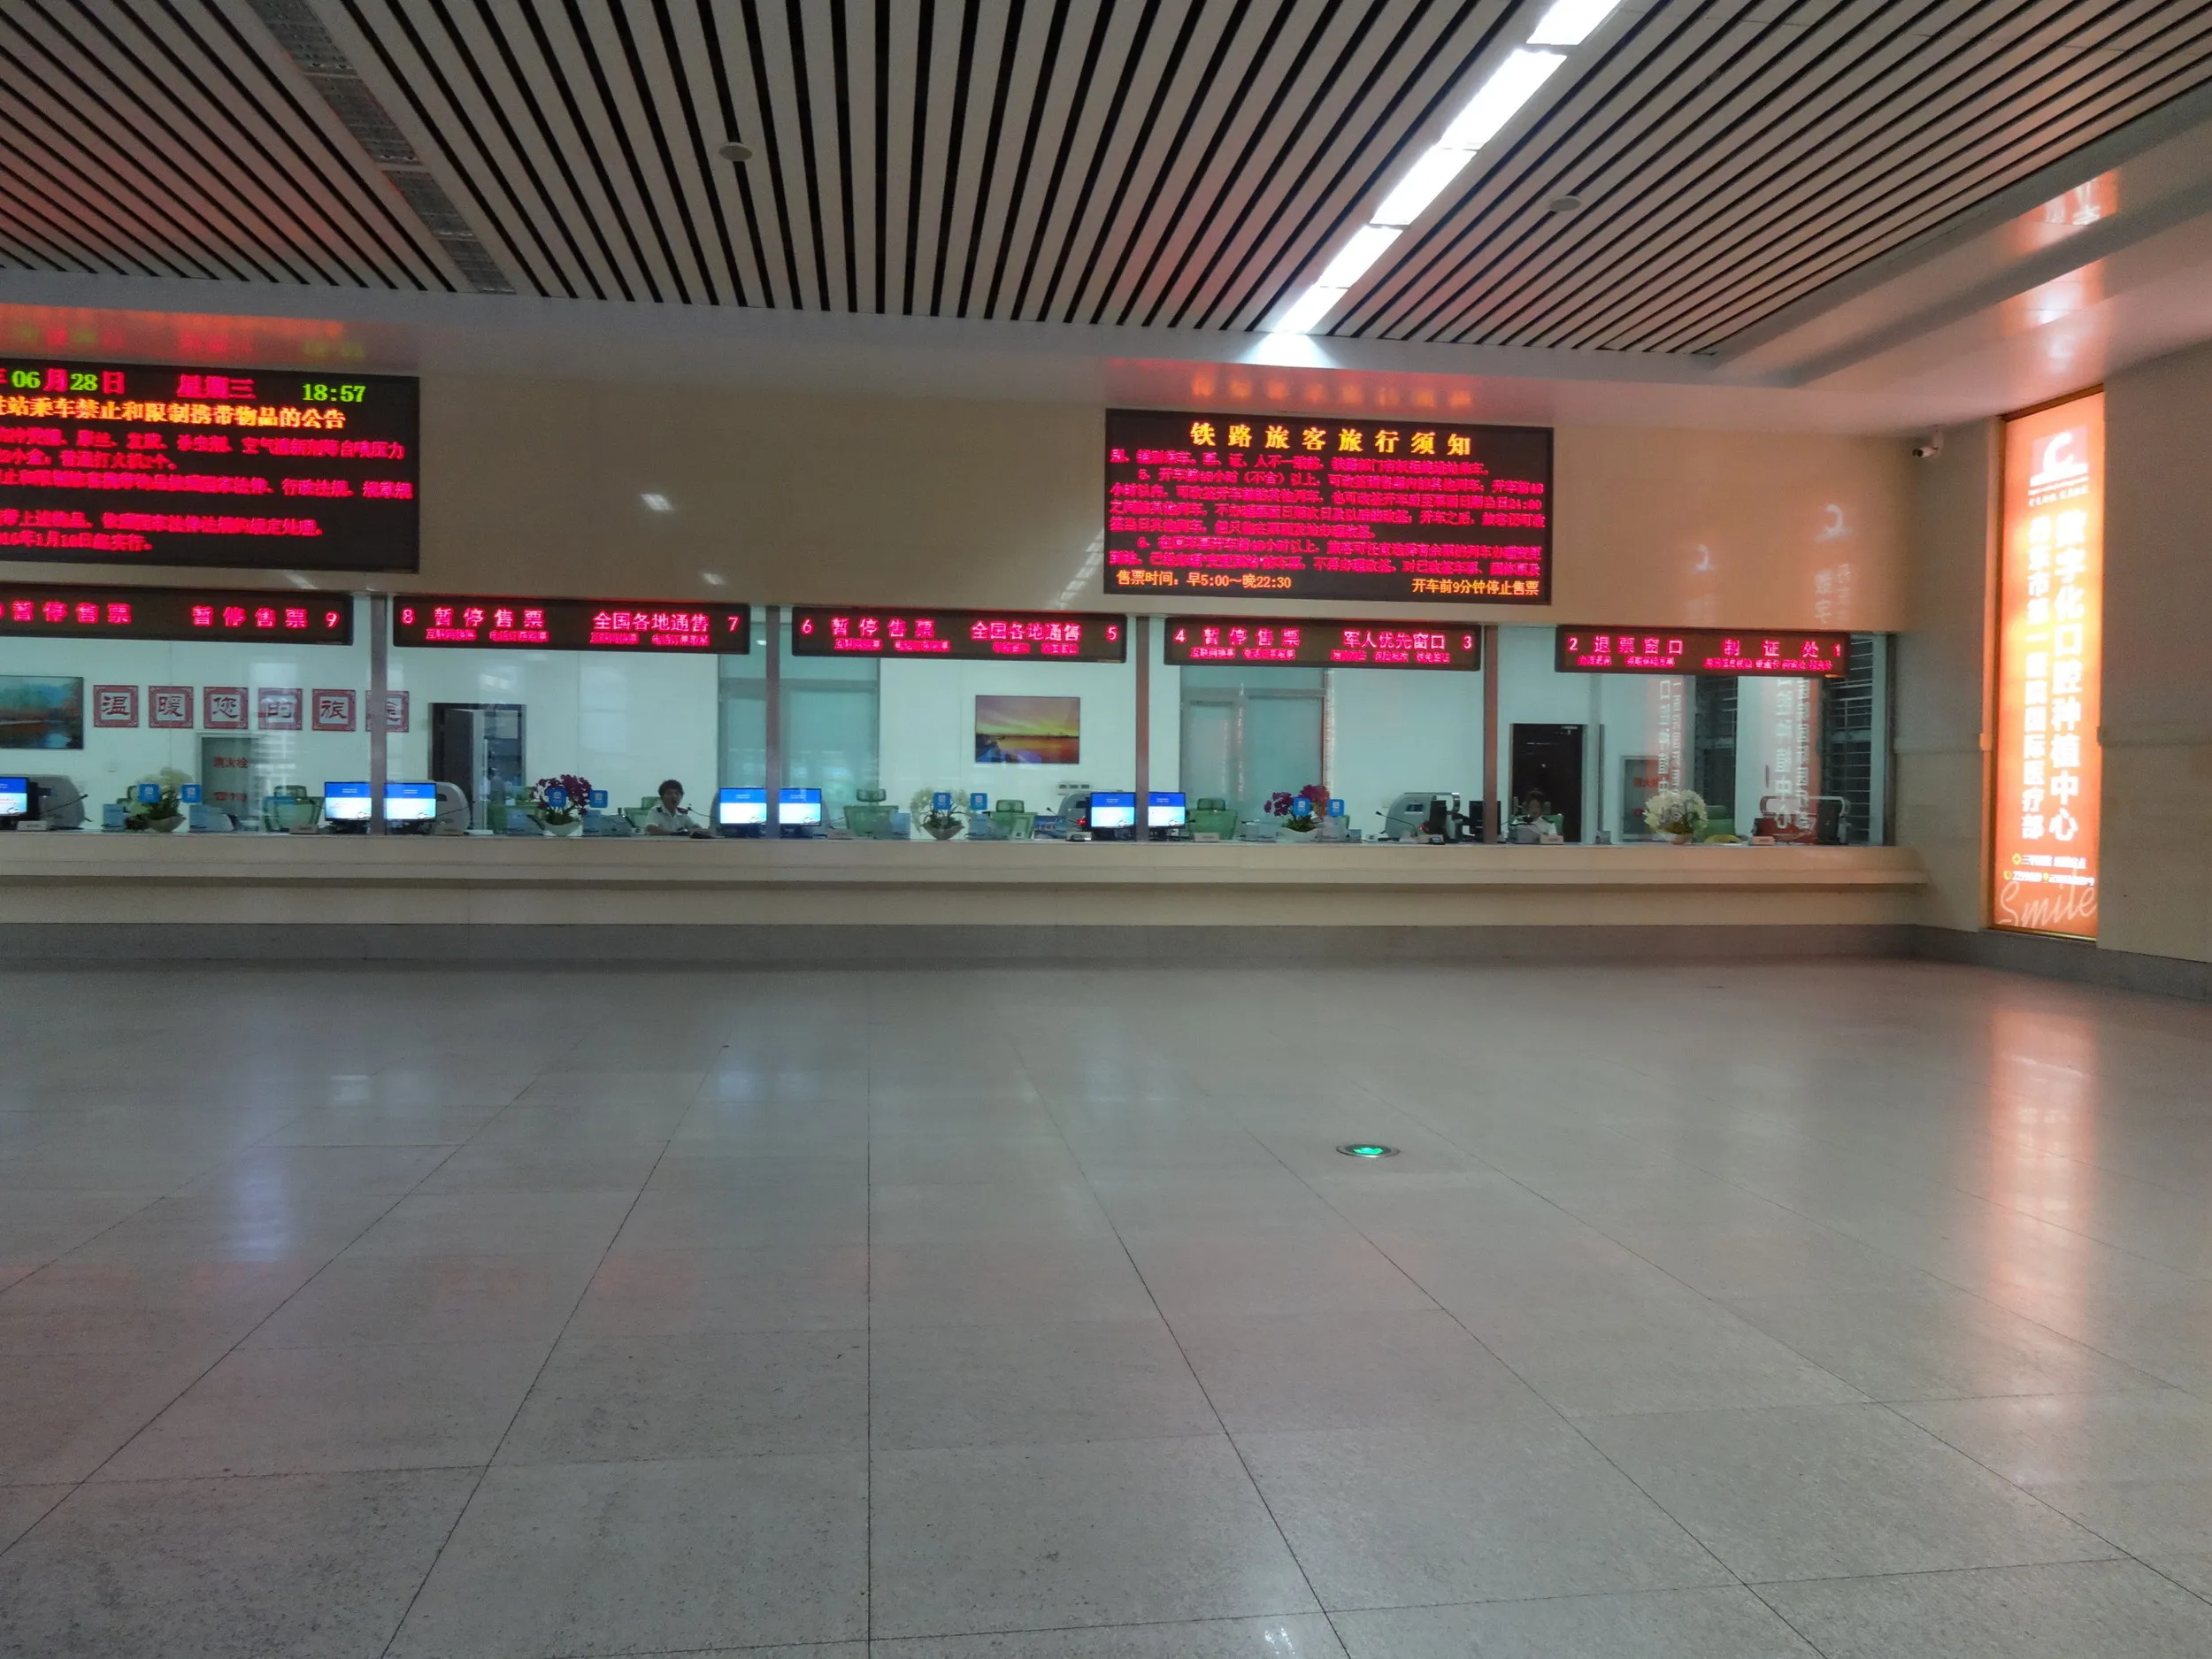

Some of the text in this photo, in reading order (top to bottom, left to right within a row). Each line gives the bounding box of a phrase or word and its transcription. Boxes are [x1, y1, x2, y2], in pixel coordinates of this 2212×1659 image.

[178, 373, 257, 400] 星期三
[303, 384, 366, 403] 18:57
[0, 396, 346, 429] 站乘车禁止和限制携带物品的公告
[1190, 422, 1472, 456] 铁路旅客旅行须知
[1411, 579, 1540, 597] 开车前9分钟停止售票
[12, 600, 132, 625] 暂停售票
[192, 605, 340, 629] 暂停售票 9
[403, 608, 545, 627] 8 暂停售票
[593, 611, 740, 633] 全国各地通售 7
[801, 618, 934, 638] 6 暂停售票
[972, 621, 1118, 642] 全国各地通售 5
[1174, 627, 1301, 647] 4 暂停售票
[1343, 630, 1473, 650] 军人优先窗口 3
[1567, 636, 1683, 655] 2 退票窗口
[1723, 640, 1820, 658] 制证处
